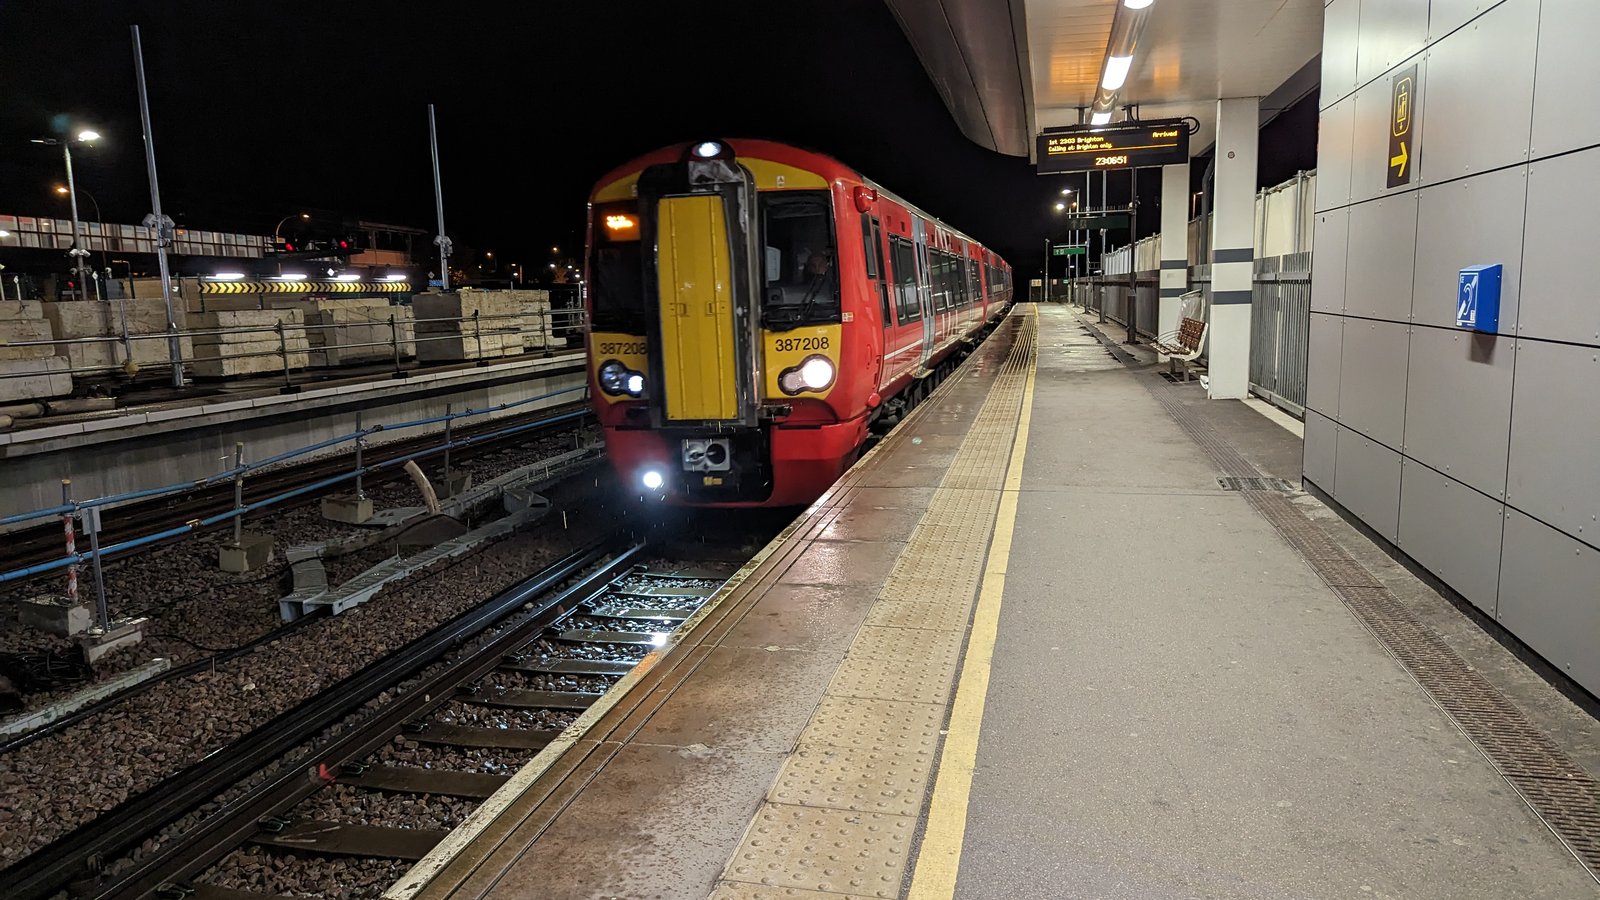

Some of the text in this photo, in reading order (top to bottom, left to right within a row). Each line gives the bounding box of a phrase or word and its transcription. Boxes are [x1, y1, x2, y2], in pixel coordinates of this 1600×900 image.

[1077, 136, 1104, 144] Brighton
[1152, 130, 1178, 138] Arrived
[1048, 144, 1067, 152] Calling
[1076, 143, 1099, 151] Brighton
[599, 342, 648, 355] 387208
[775, 336, 830, 352] 387208
